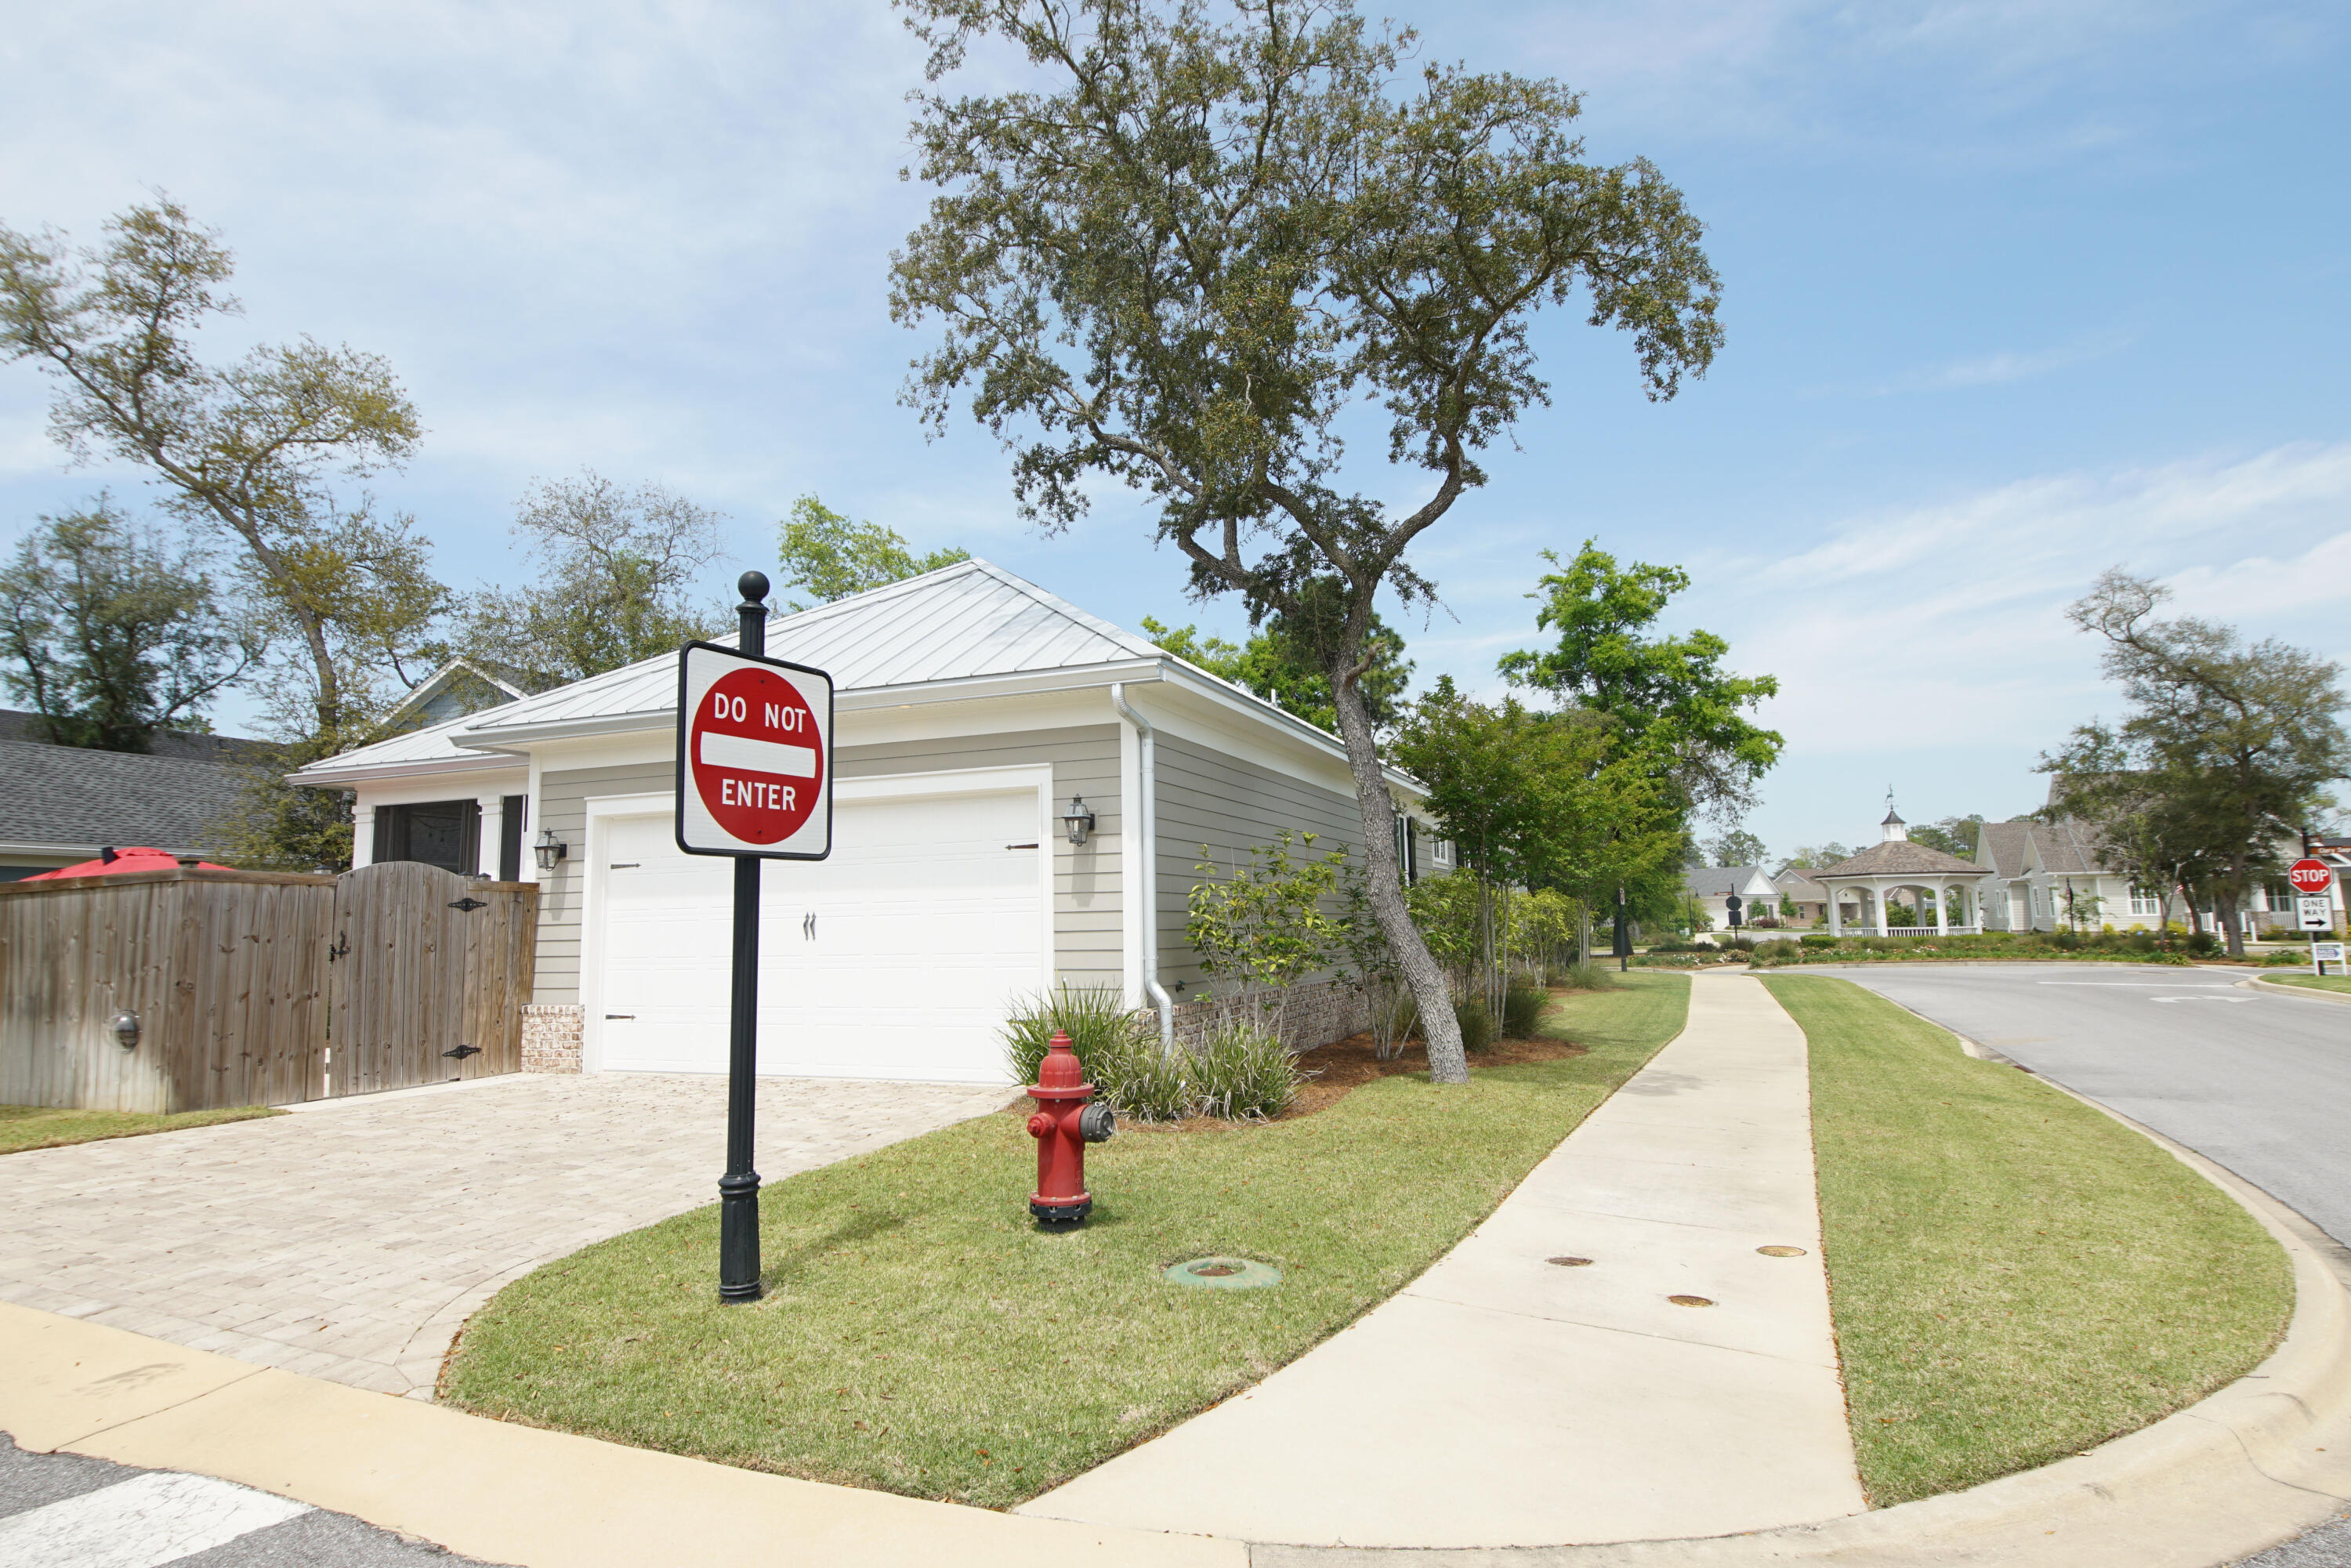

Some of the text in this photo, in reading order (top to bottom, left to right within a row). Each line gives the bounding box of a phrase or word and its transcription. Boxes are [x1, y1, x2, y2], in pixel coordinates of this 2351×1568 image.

[714, 693, 806, 733] DO NOT
[722, 778, 795, 811] ENTER
[2292, 869, 2329, 882] STOP
